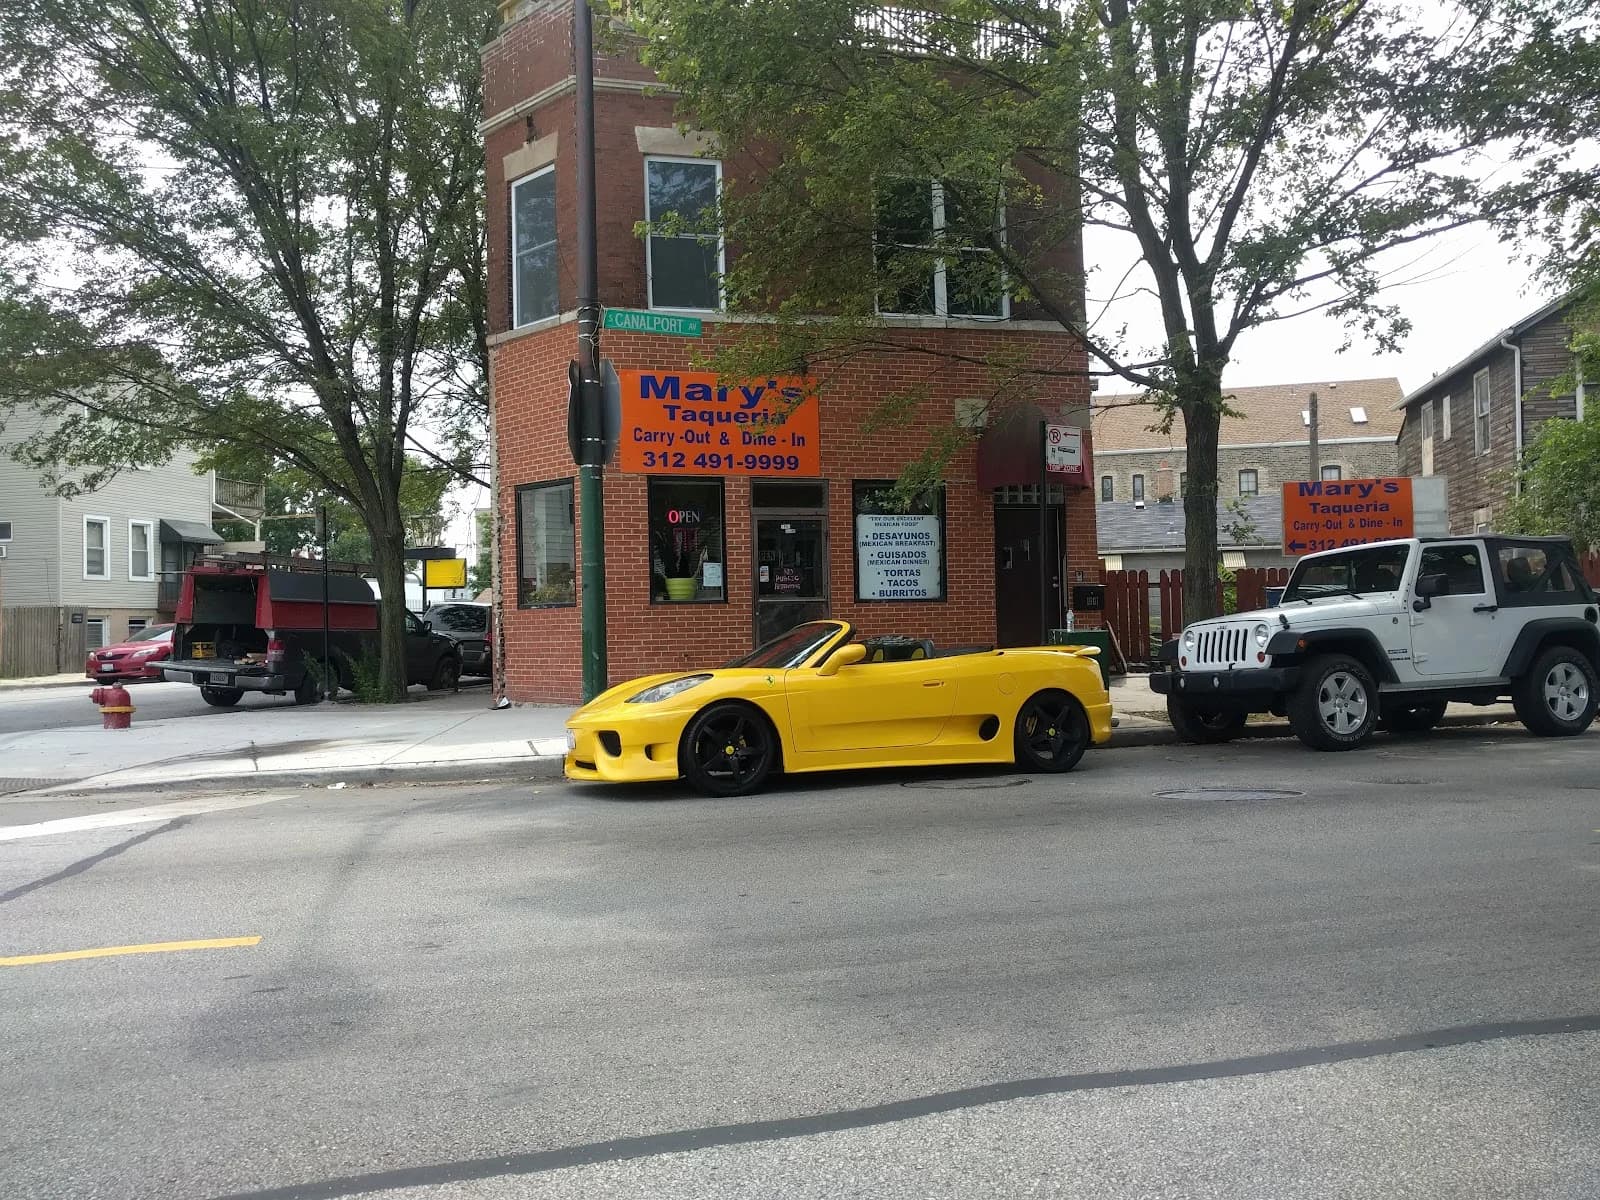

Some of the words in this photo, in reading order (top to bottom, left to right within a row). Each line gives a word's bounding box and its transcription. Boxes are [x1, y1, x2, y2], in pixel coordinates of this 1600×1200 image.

[608, 314, 614, 323] S
[615, 312, 684, 333] CANALPORT
[688, 322, 697, 331] AV
[640, 374, 802, 410] Mary's
[663, 404, 787, 427] Taqueria
[633, 427, 675, 447] Carry
[719, 431, 730, 446] &
[791, 432, 806, 447] In
[642, 451, 686, 468] 312
[693, 452, 800, 471] 491-9999
[1298, 478, 1400, 499] Mary's
[1309, 502, 1390, 516] Taqueria
[668, 510, 701, 524] OPEN
[1293, 520, 1320, 533] Carry
[1348, 518, 1356, 529] &
[1359, 517, 1383, 529] Dine
[1392, 516, 1403, 527] In
[872, 532, 930, 540] DESAYUNOS
[1308, 538, 1336, 551] 312
[877, 551, 927, 559] GUISADOS
[884, 569, 921, 577] TORTAS
[887, 579, 919, 587] TACOS
[879, 589, 927, 597] BURRITOS
